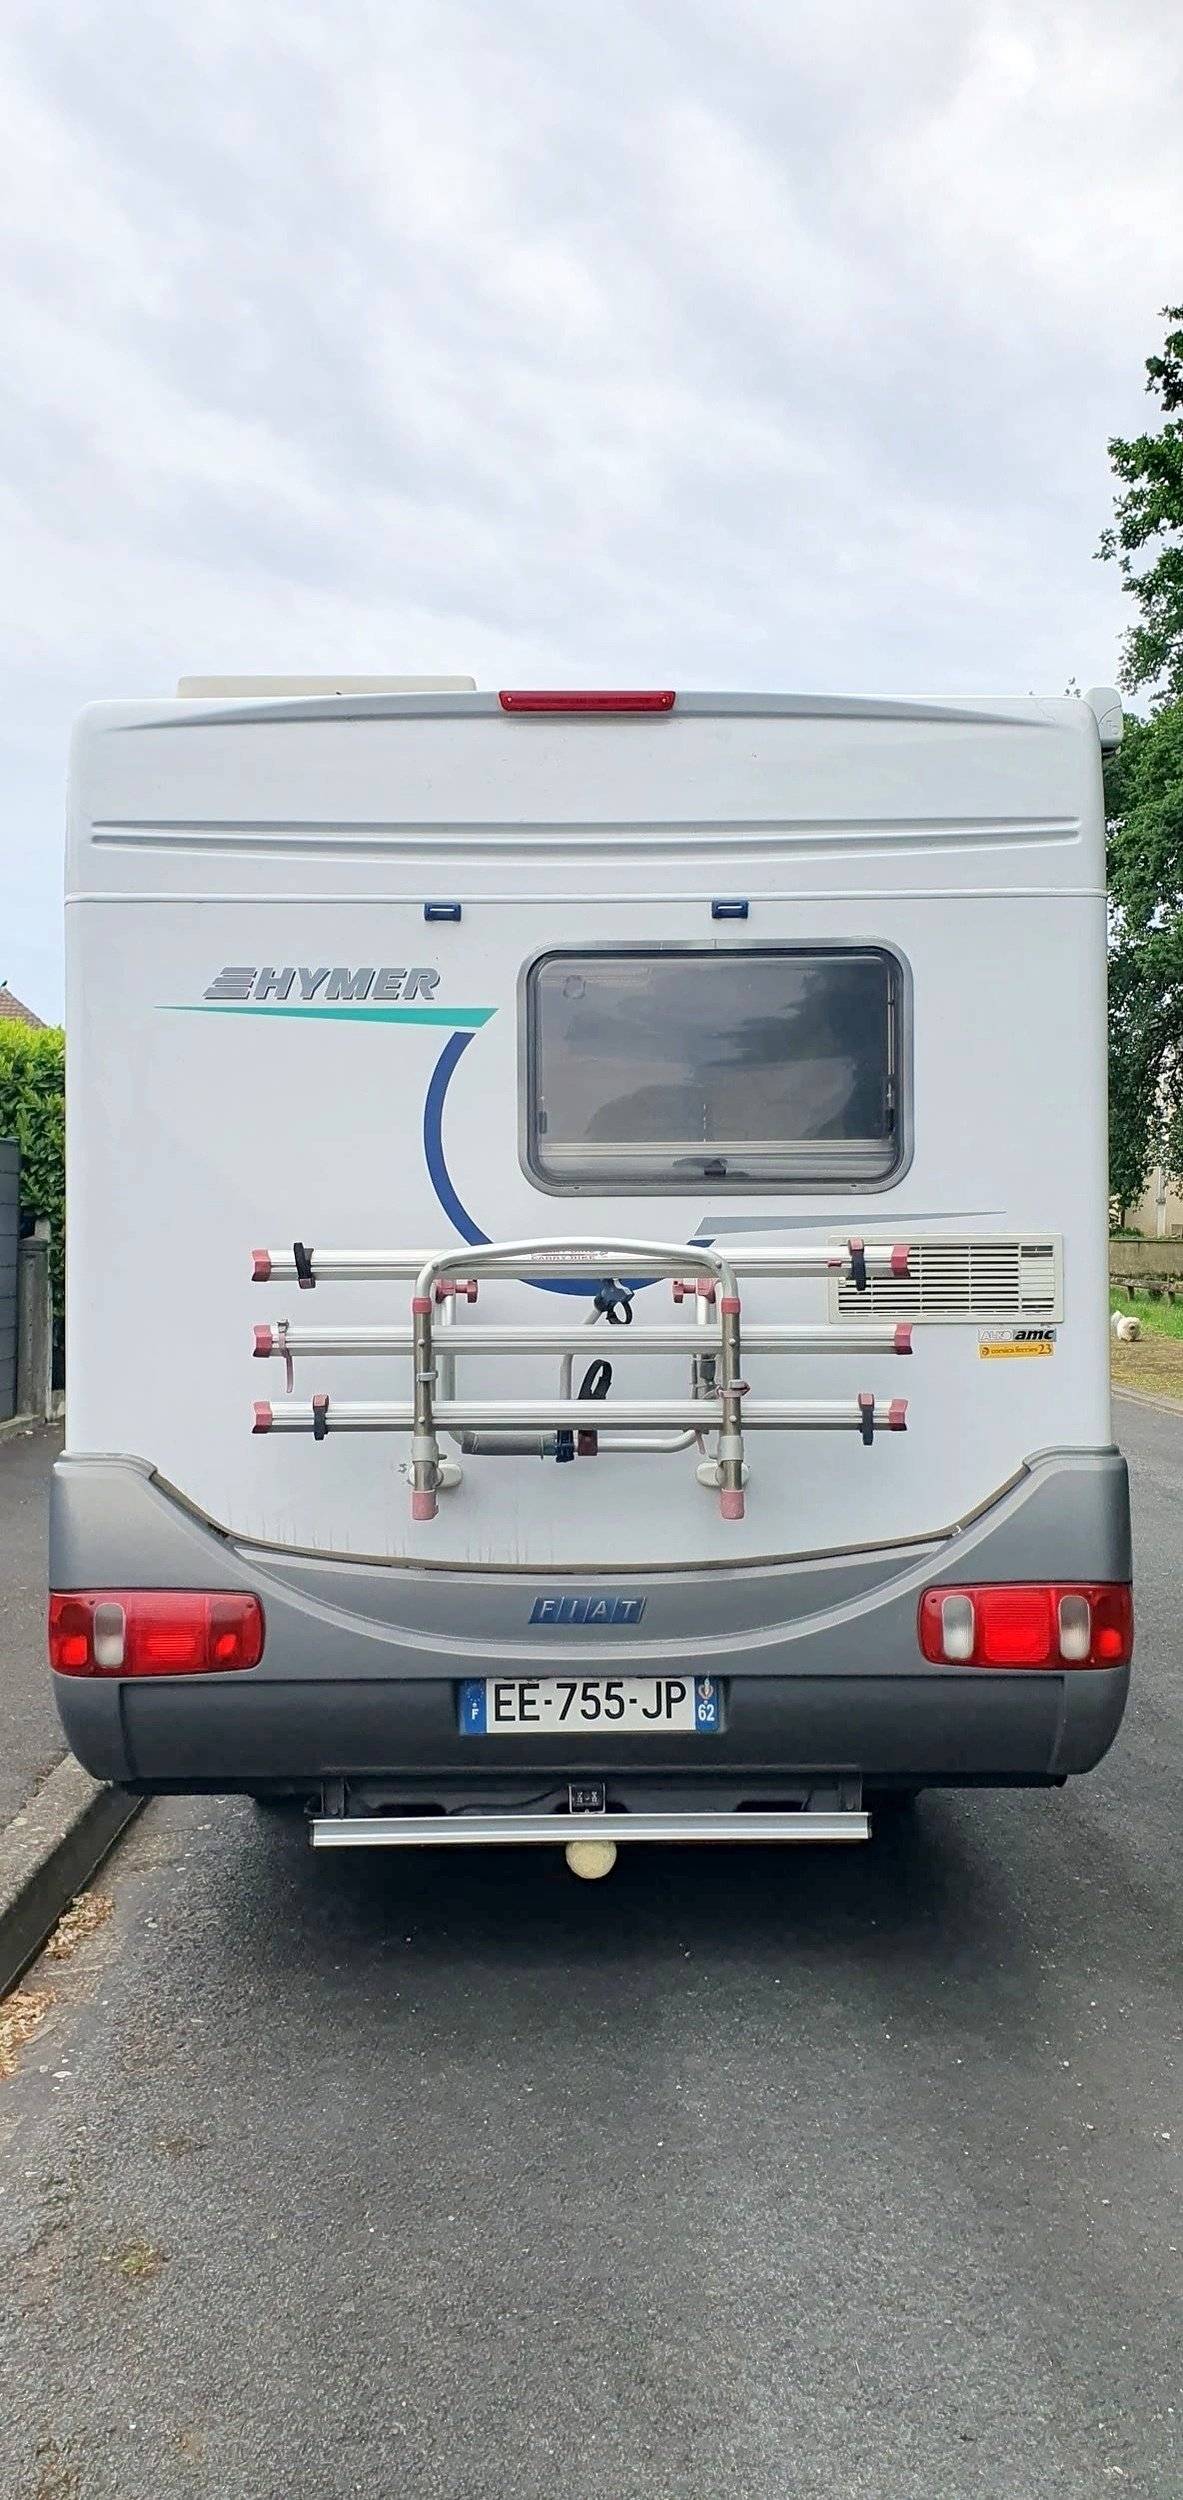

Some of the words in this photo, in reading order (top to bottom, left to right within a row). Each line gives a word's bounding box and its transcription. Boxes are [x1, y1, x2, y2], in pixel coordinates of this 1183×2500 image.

[252, 967, 440, 1000] HYMER
[1014, 1329, 1054, 1340] amc
[540, 1600, 637, 1618] FIAT
[494, 1681, 686, 1721] EE-755-JP
[471, 1708, 479, 1720] F
[698, 1704, 715, 1722] 62
